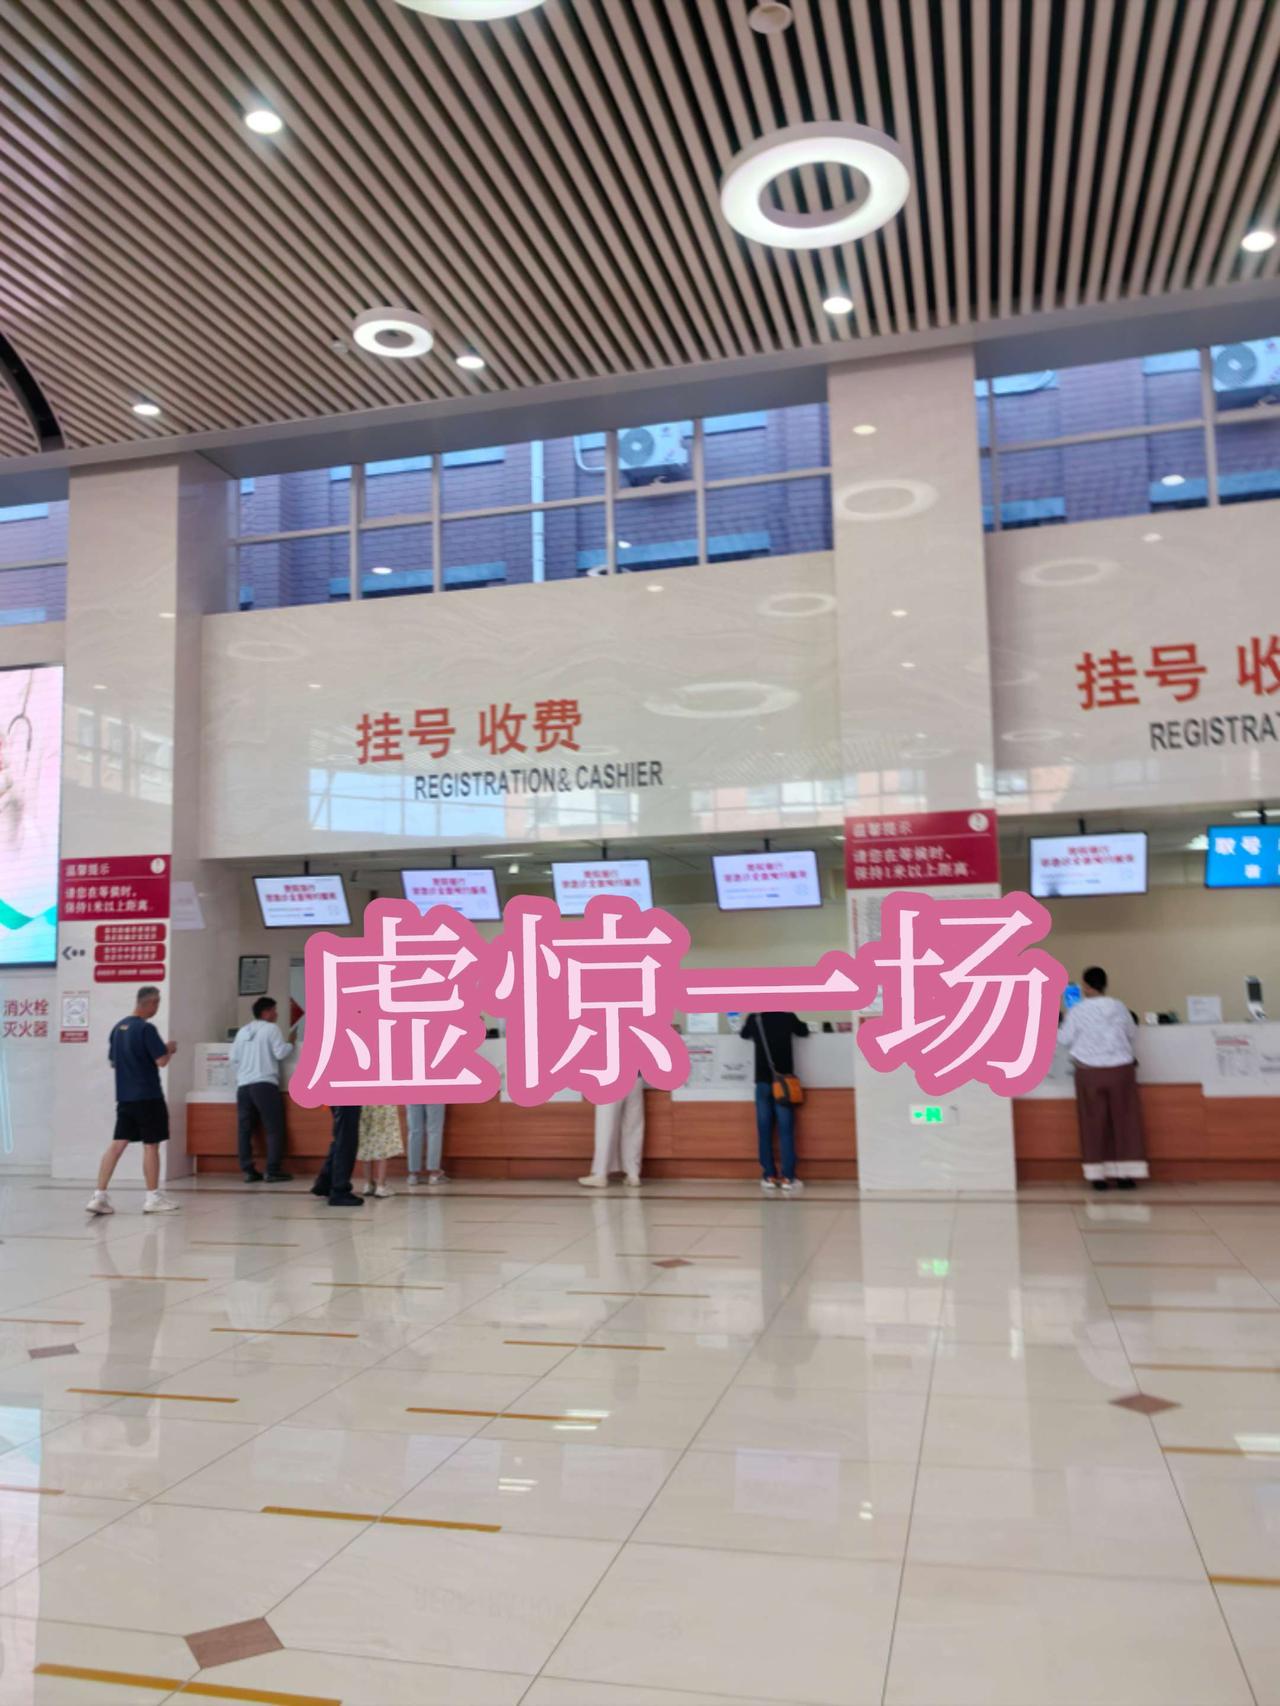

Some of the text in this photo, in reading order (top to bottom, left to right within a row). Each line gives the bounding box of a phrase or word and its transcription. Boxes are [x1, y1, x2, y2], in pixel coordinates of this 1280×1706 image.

[1075, 643, 1208, 711] 挂号
[356, 699, 583, 765] 挂号 收费
[1149, 711, 1280, 751] REGISTRA
[575, 760, 664, 791] CASHIER
[3, 998, 48, 1016] 消火栓
[3, 1020, 48, 1038] 灭火器
